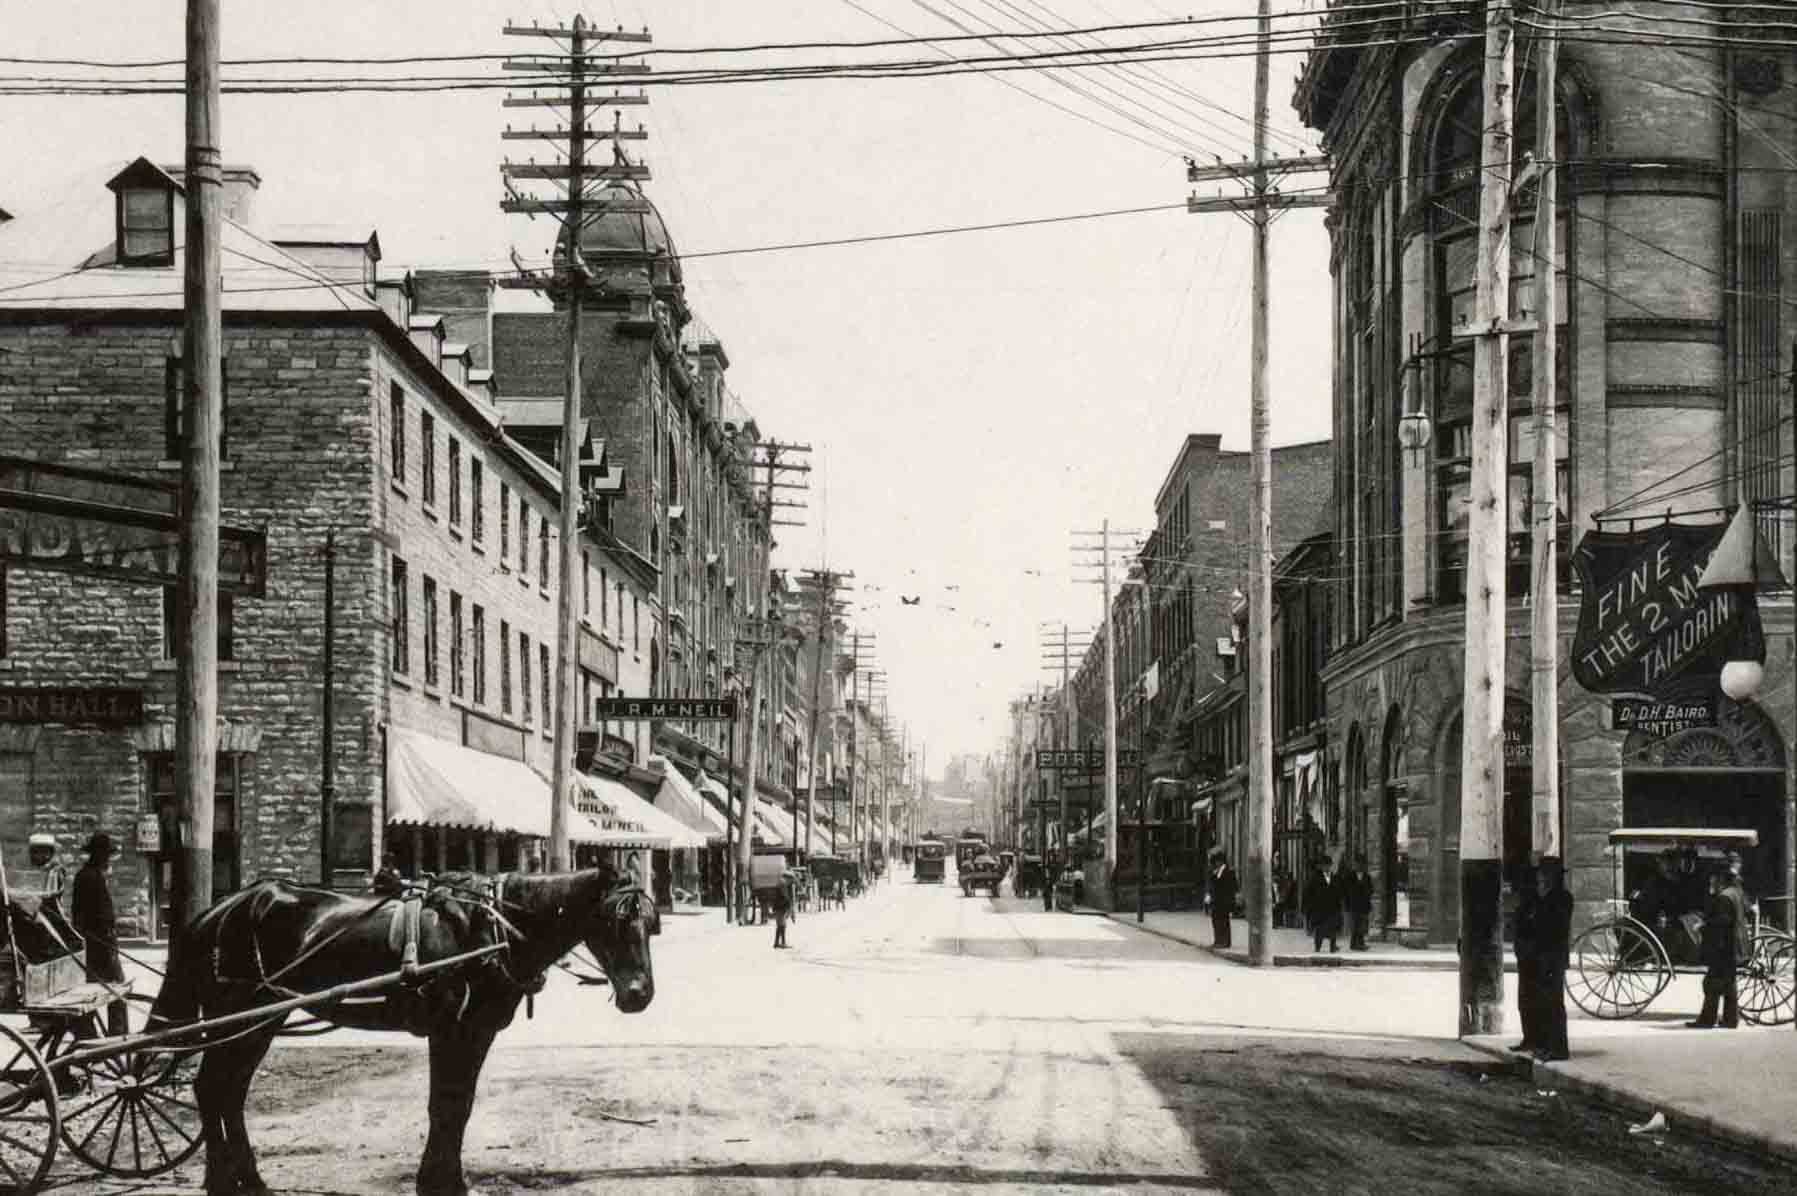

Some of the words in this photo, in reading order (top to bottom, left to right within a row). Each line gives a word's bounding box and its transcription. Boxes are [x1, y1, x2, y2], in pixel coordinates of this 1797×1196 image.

[1599, 540, 1672, 630] FINE
[1581, 623, 1641, 678] THE
[1641, 602, 1670, 633] 2
[1665, 704, 1707, 719] BAIRD
